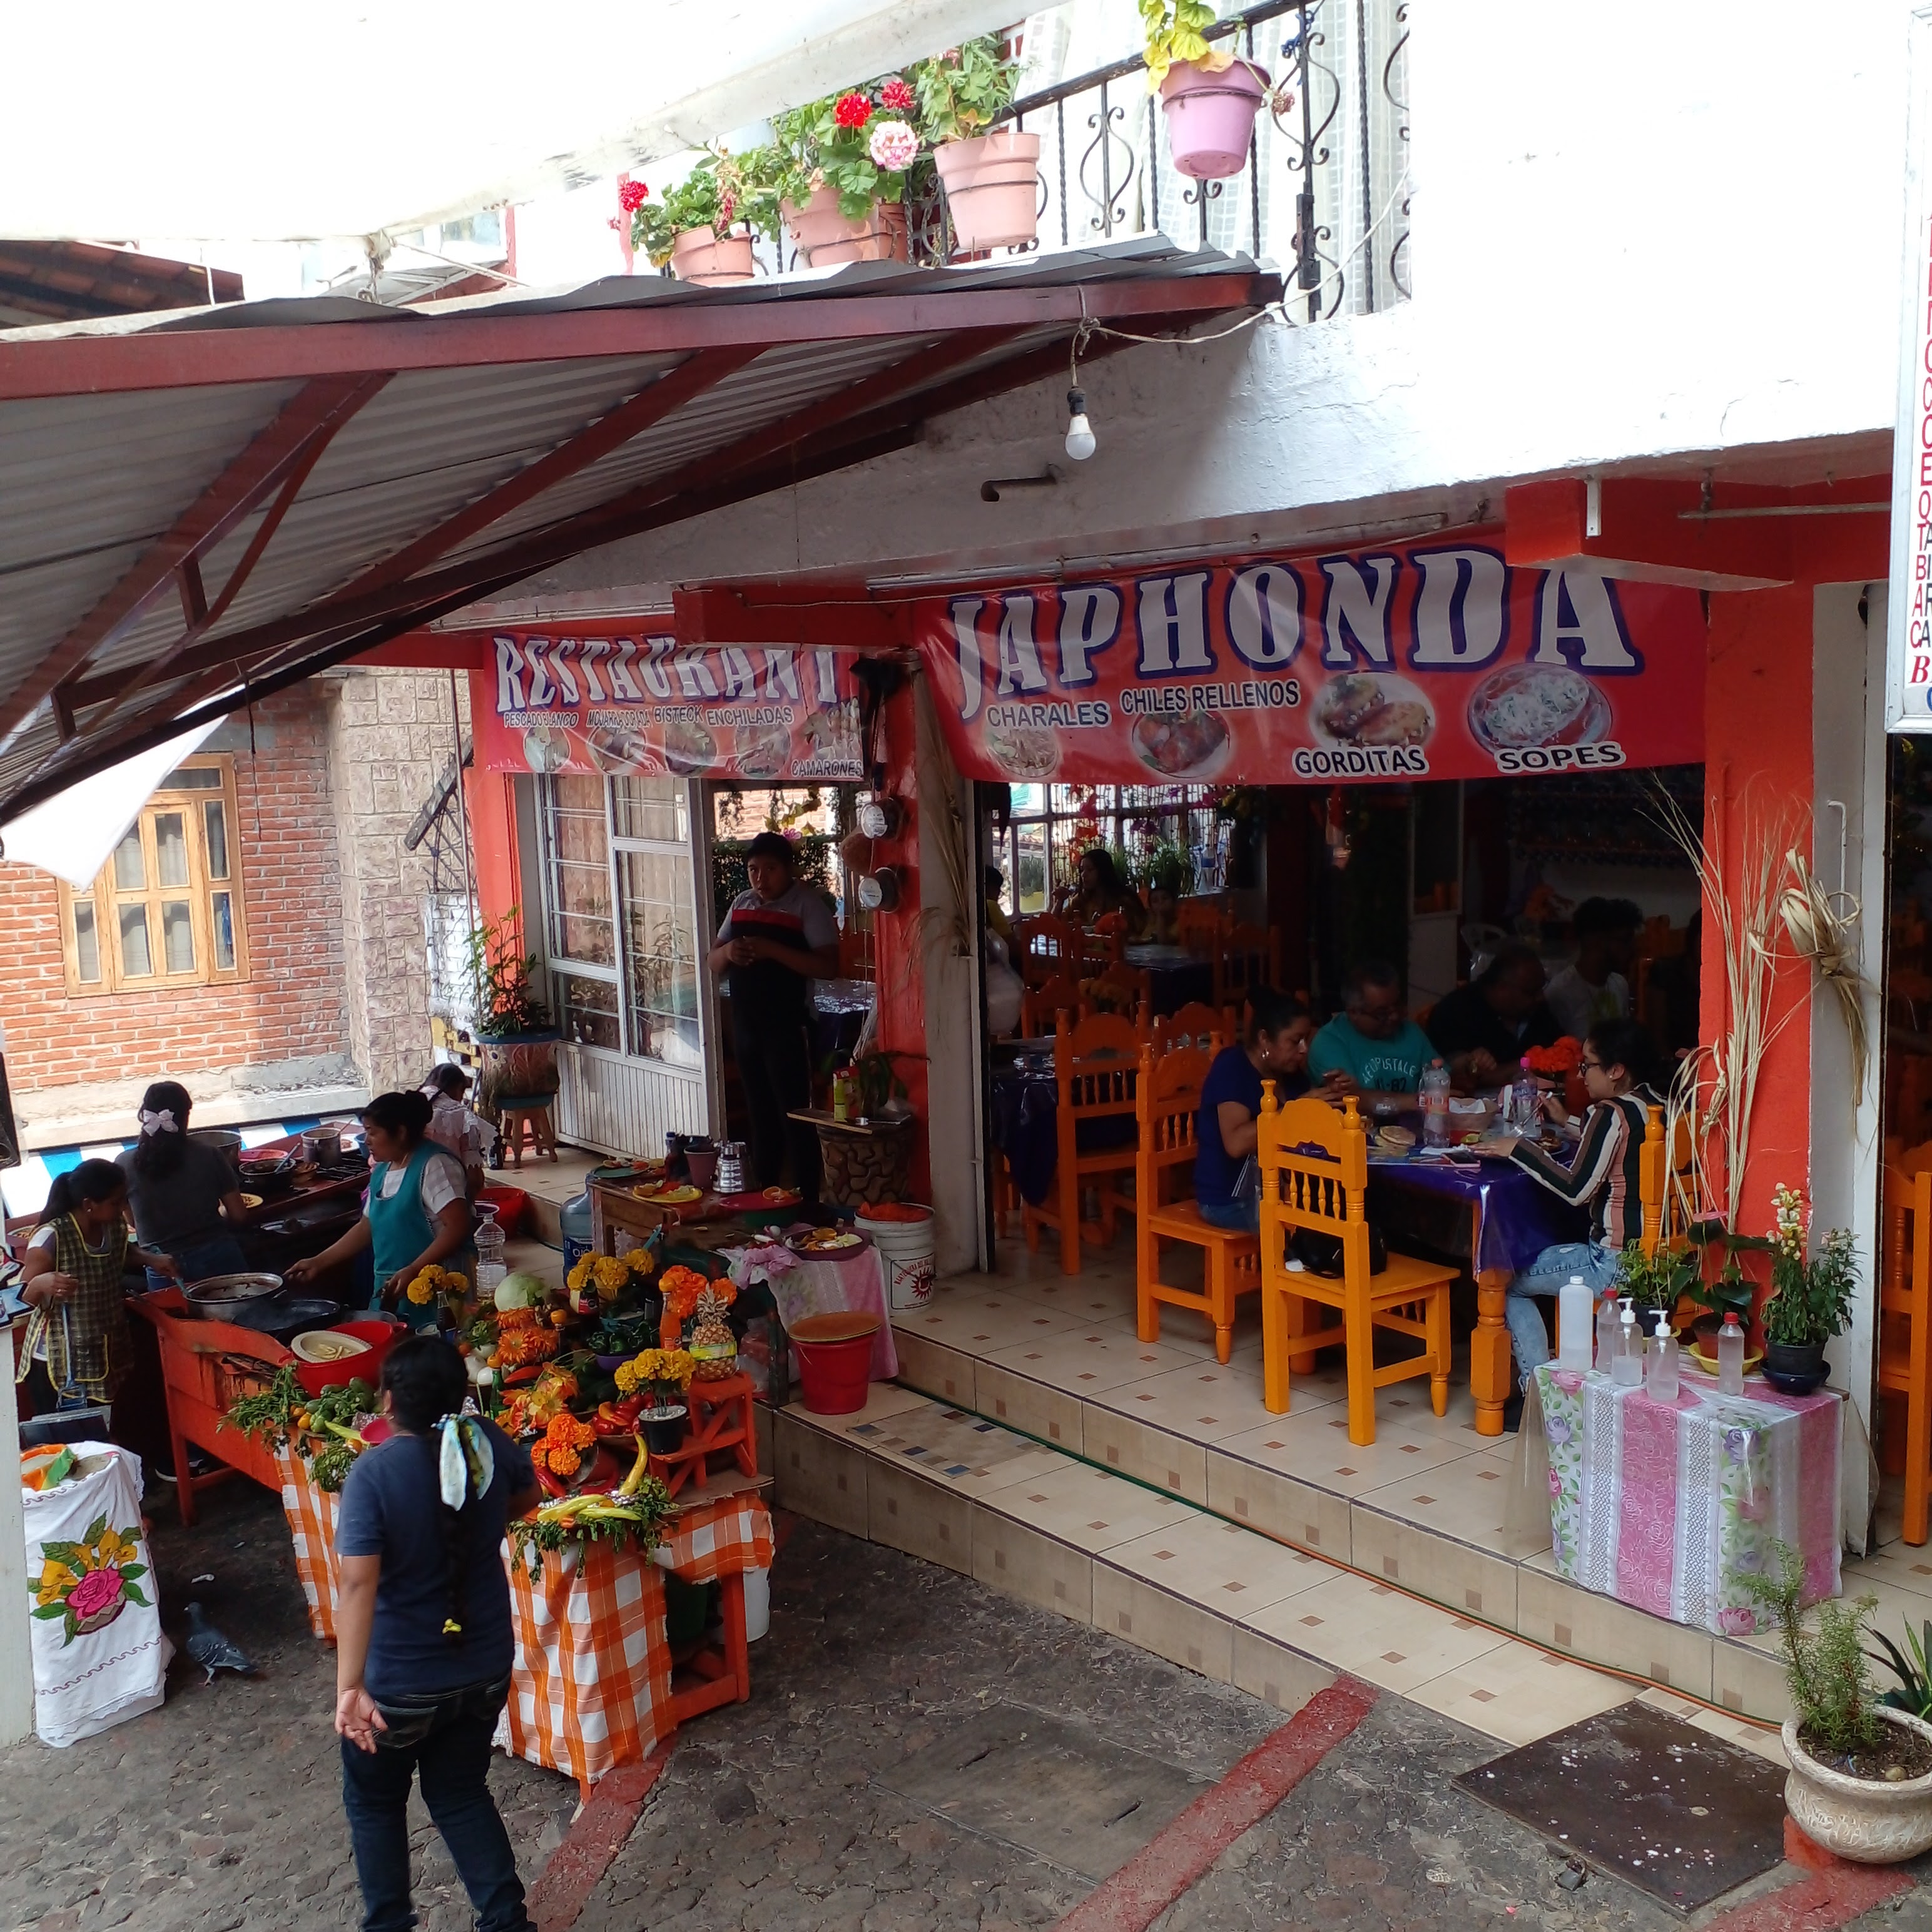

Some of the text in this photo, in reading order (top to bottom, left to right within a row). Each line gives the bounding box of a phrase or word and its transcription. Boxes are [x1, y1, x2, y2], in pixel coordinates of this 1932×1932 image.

[949, 546, 1643, 723] JAPHONDA
[492, 634, 840, 714] RESTAURANT
[1122, 681, 1299, 714] CHILES RELLENOS
[504, 712, 579, 727] PESCADO BLANCO
[654, 707, 703, 723] BISTECK
[707, 708, 794, 726] ENCHILADAS
[987, 702, 1111, 727] CHARALES
[792, 760, 862, 776] CAMARONES
[1294, 747, 1428, 775] GORDITAS
[1498, 743, 1624, 773] SOPES
